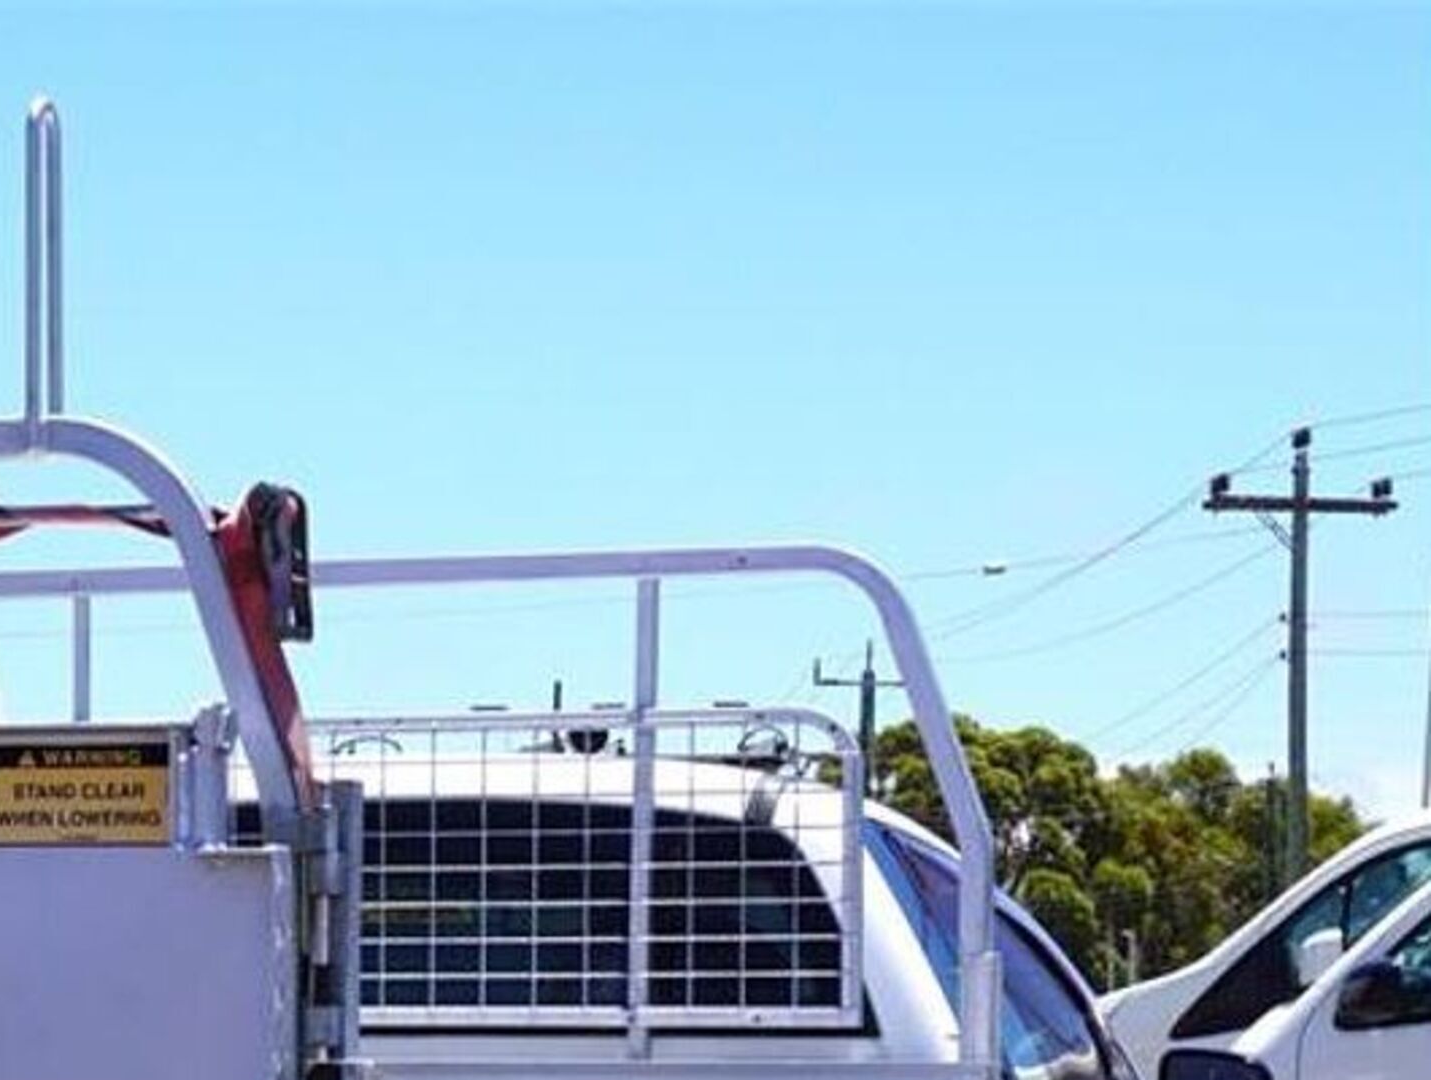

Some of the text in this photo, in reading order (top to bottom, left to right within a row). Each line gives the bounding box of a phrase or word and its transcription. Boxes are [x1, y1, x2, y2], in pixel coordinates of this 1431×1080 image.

[42, 750, 142, 767] WARNING
[13, 782, 146, 801] STAND CLEAR
[57, 809, 162, 829] LOWERING
